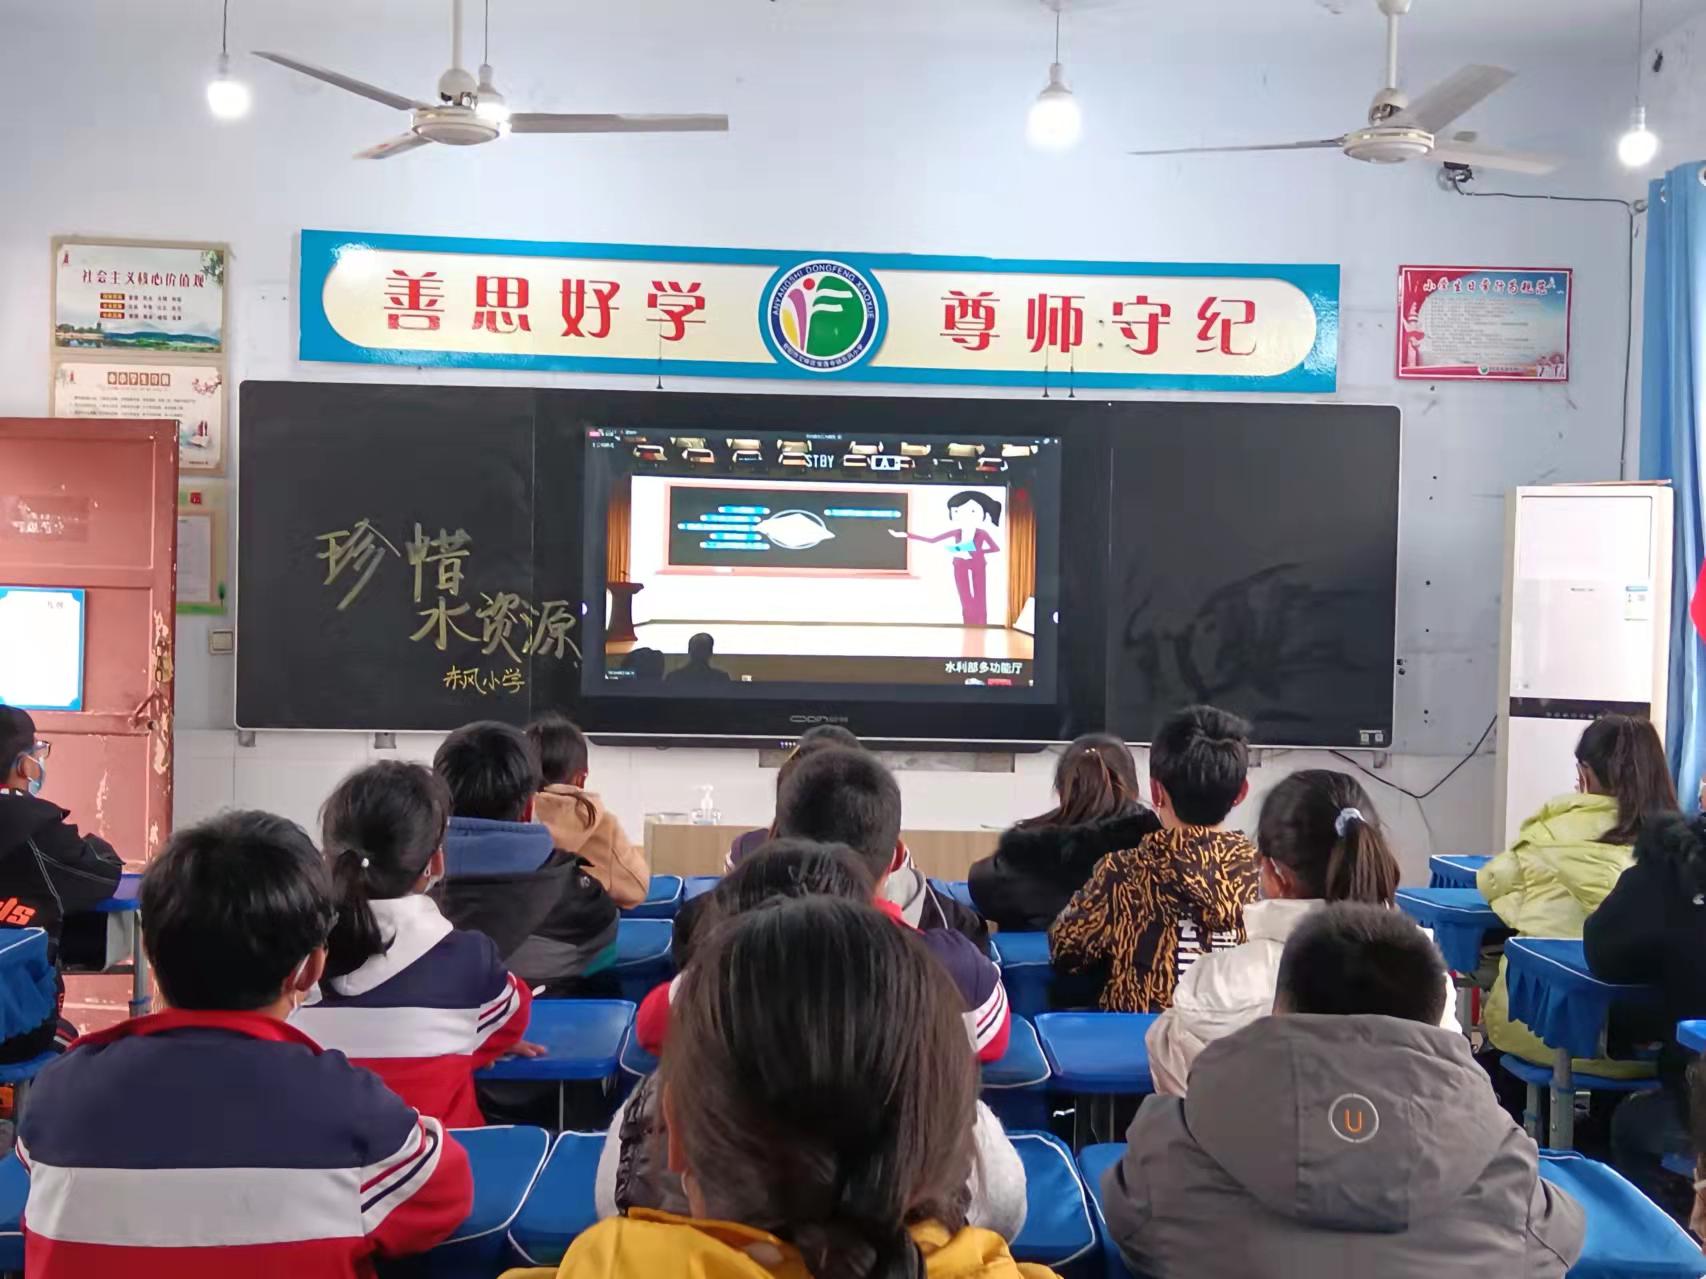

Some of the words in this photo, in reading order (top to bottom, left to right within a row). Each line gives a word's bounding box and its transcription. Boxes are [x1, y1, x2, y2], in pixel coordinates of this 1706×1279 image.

[82, 269, 205, 288] 社会主义核心价值观
[806, 264, 855, 281] DONGFENG
[856, 280, 874, 318] XIAOXUE
[384, 269, 706, 341] 善思好学
[940, 290, 1257, 356] 尊师守纪
[806, 454, 834, 468] STBY
[316, 518, 472, 610] 珍惜
[409, 591, 583, 668] 水资源
[945, 661, 1023, 675] 水利部多功能厅
[1345, 1109, 1362, 1133] U
